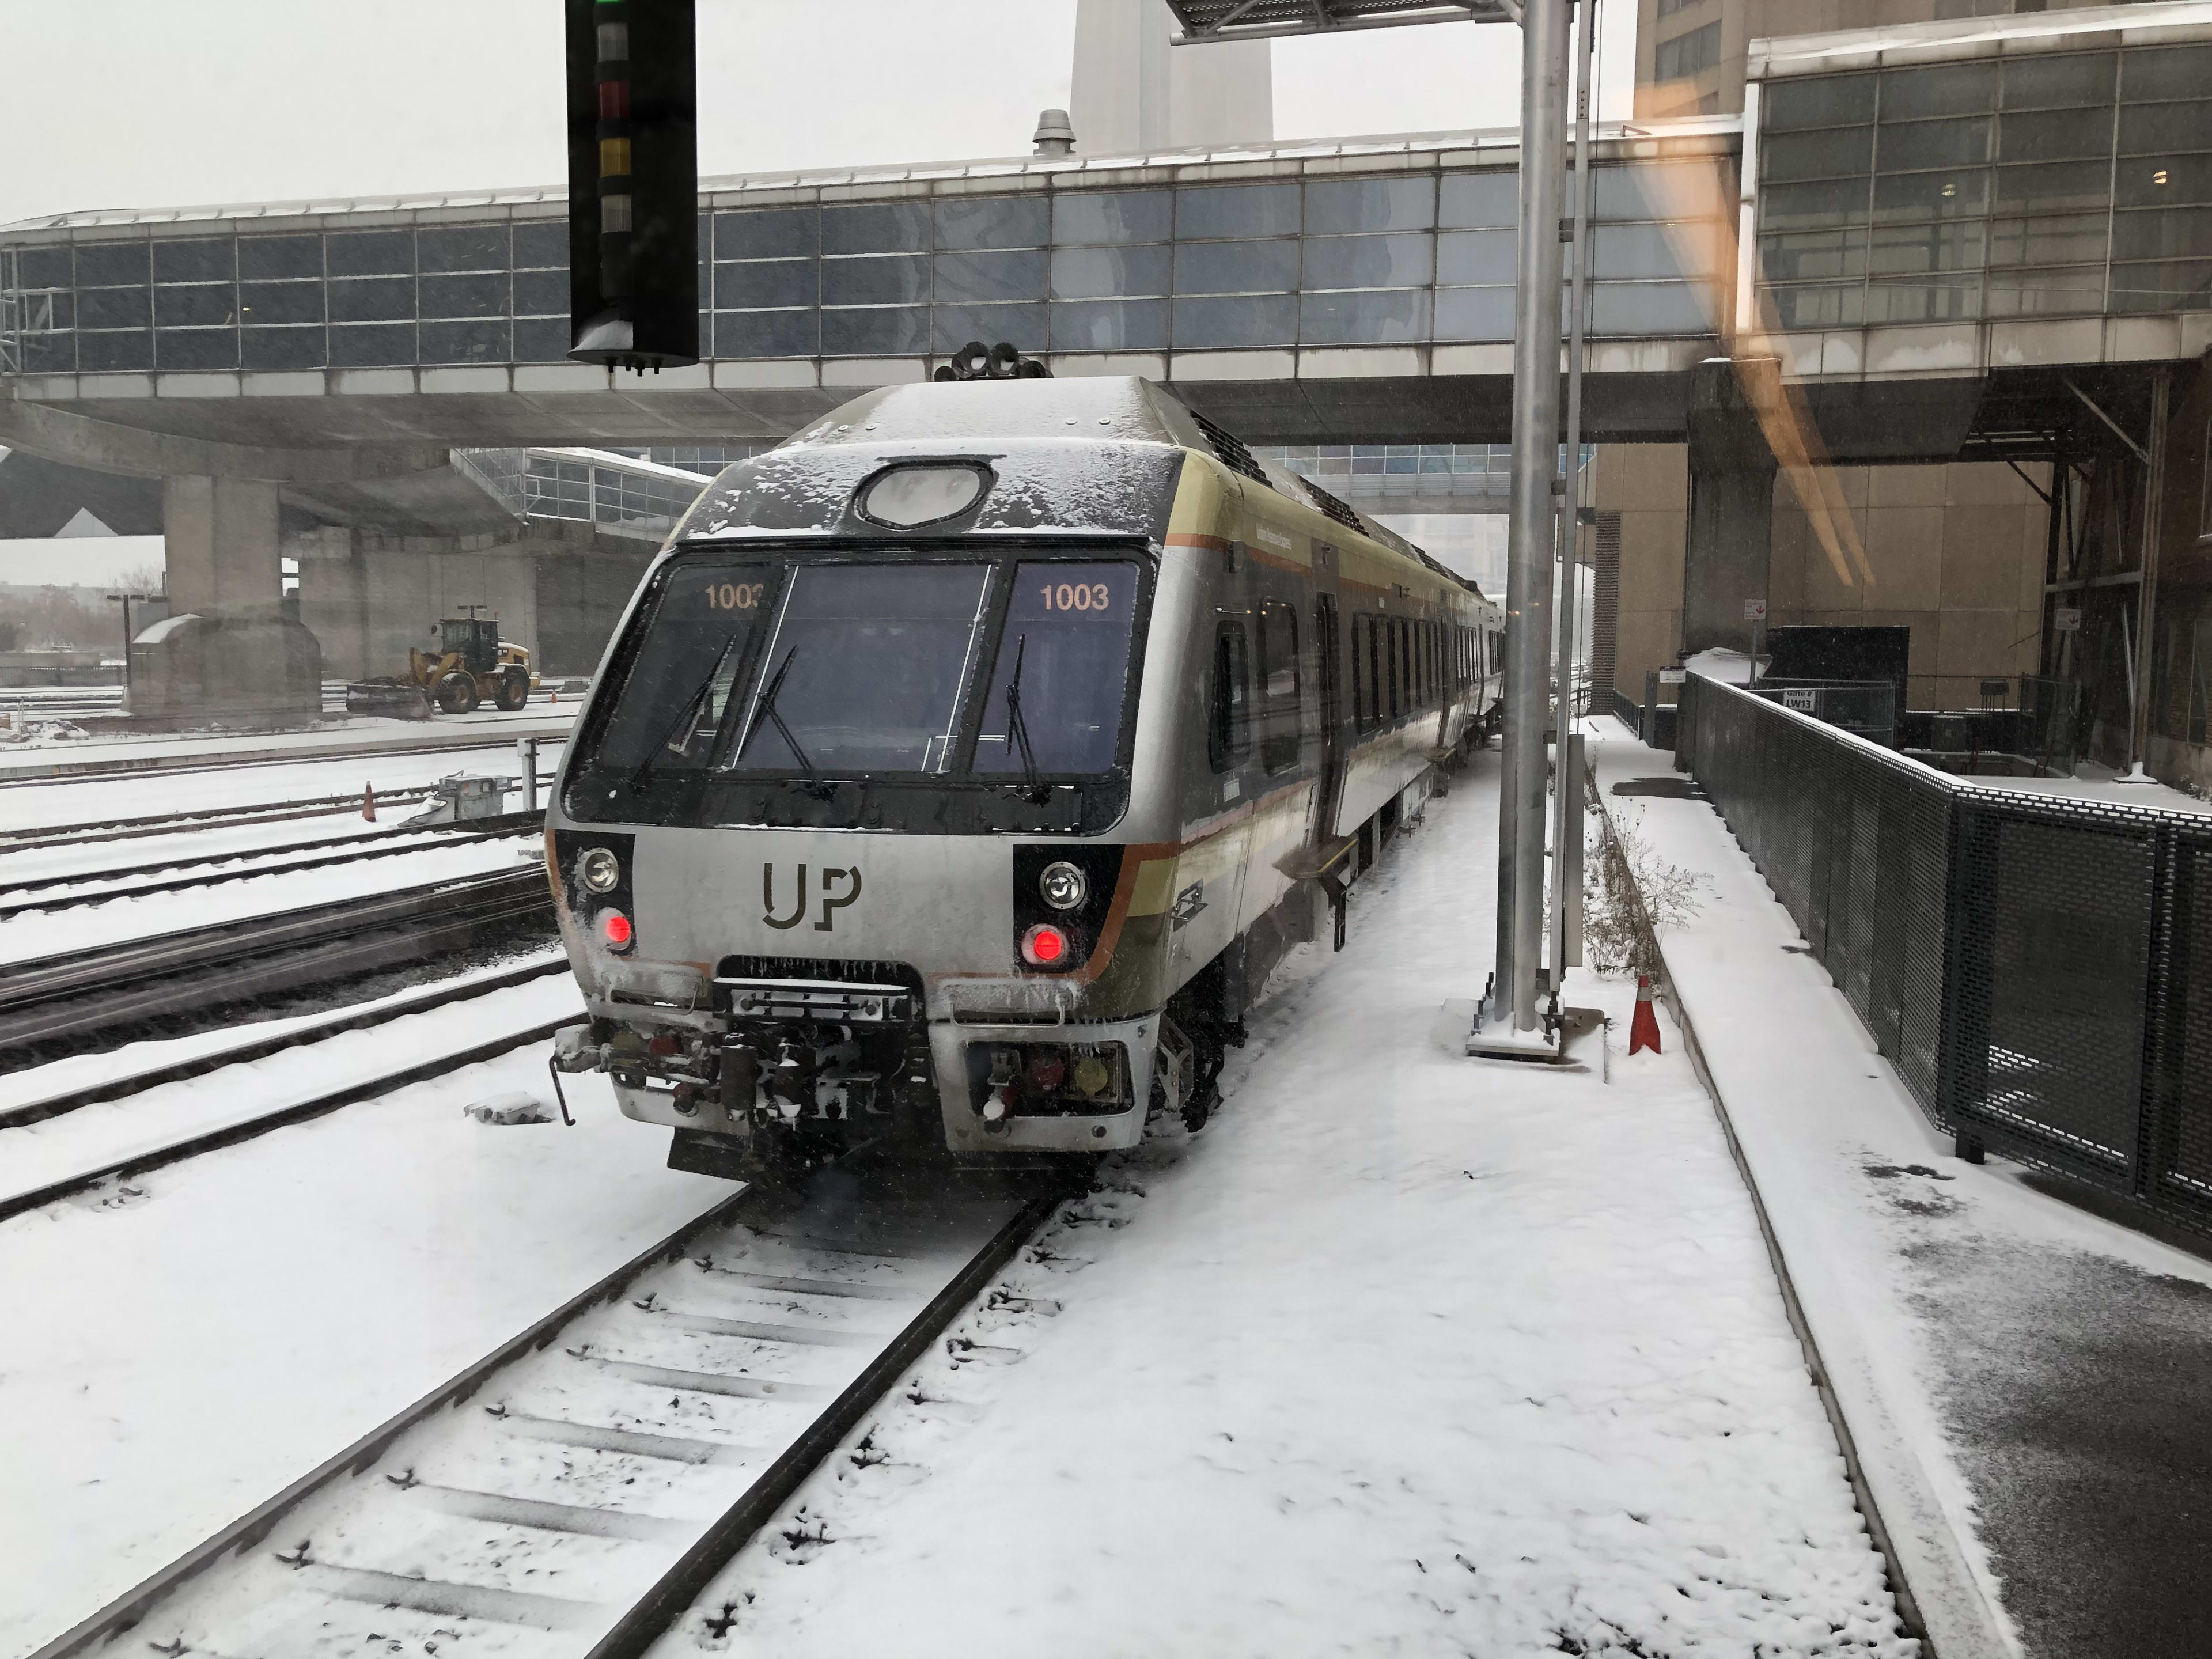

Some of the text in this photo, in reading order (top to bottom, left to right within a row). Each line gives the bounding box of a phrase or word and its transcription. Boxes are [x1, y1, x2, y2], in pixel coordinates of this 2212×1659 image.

[1040, 584, 1109, 610] 1003
[1786, 699, 1812, 708] LW13
[763, 862, 862, 931] UP
